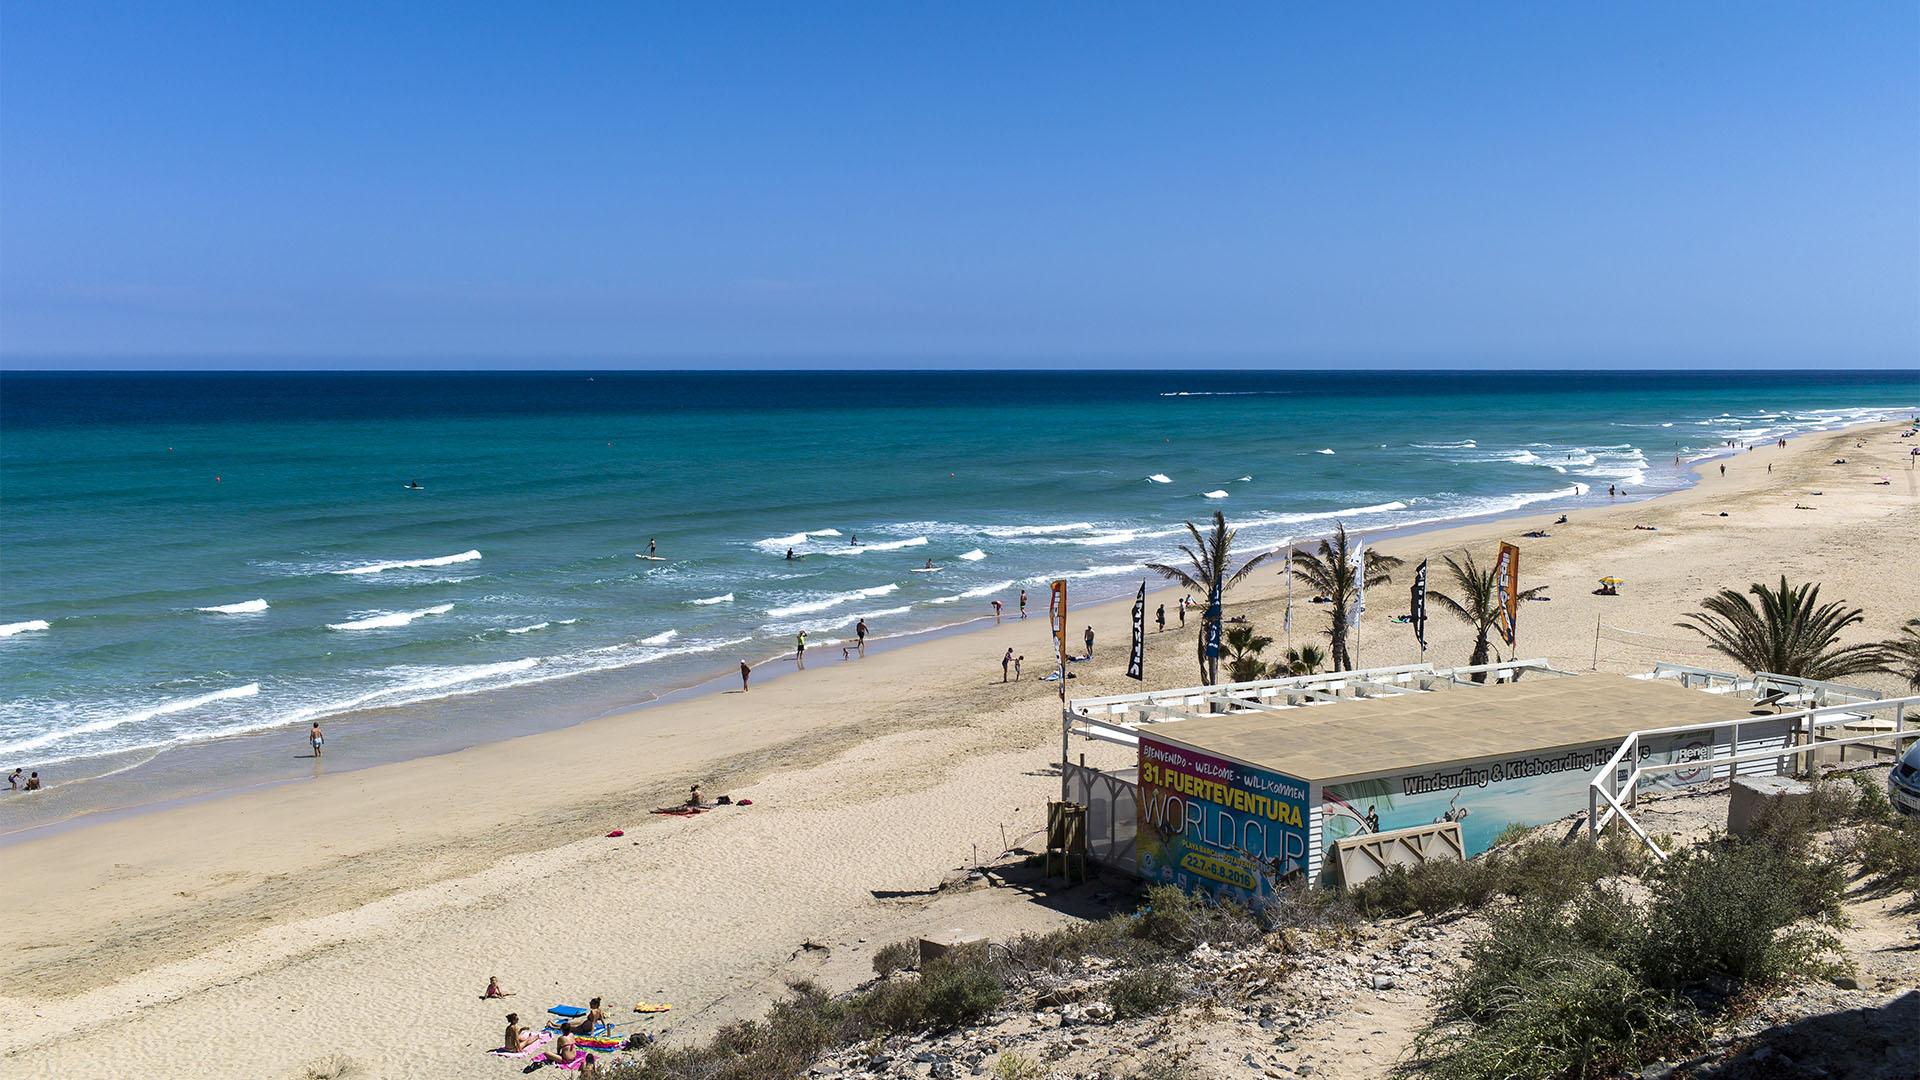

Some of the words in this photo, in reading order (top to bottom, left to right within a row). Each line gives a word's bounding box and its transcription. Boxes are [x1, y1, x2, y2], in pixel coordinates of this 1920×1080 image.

[1130, 602, 1143, 675] MYSTIC
[1143, 745, 1187, 767] BIENVENIDO
[1195, 761, 1235, 781] WELCOME
[1244, 775, 1305, 801] WILLKOMMEN
[1403, 767, 1489, 796] Windsurfing
[1491, 764, 1503, 781] &
[1506, 752, 1592, 780] Kiteboarding
[1680, 744, 1708, 758] René
[1143, 762, 1163, 786] 31.
[1165, 768, 1303, 829] FUERTEVENTURA
[1141, 786, 1236, 850] WORLD
[1243, 819, 1305, 872] CUP
[1182, 839, 1198, 852] PLAYA
